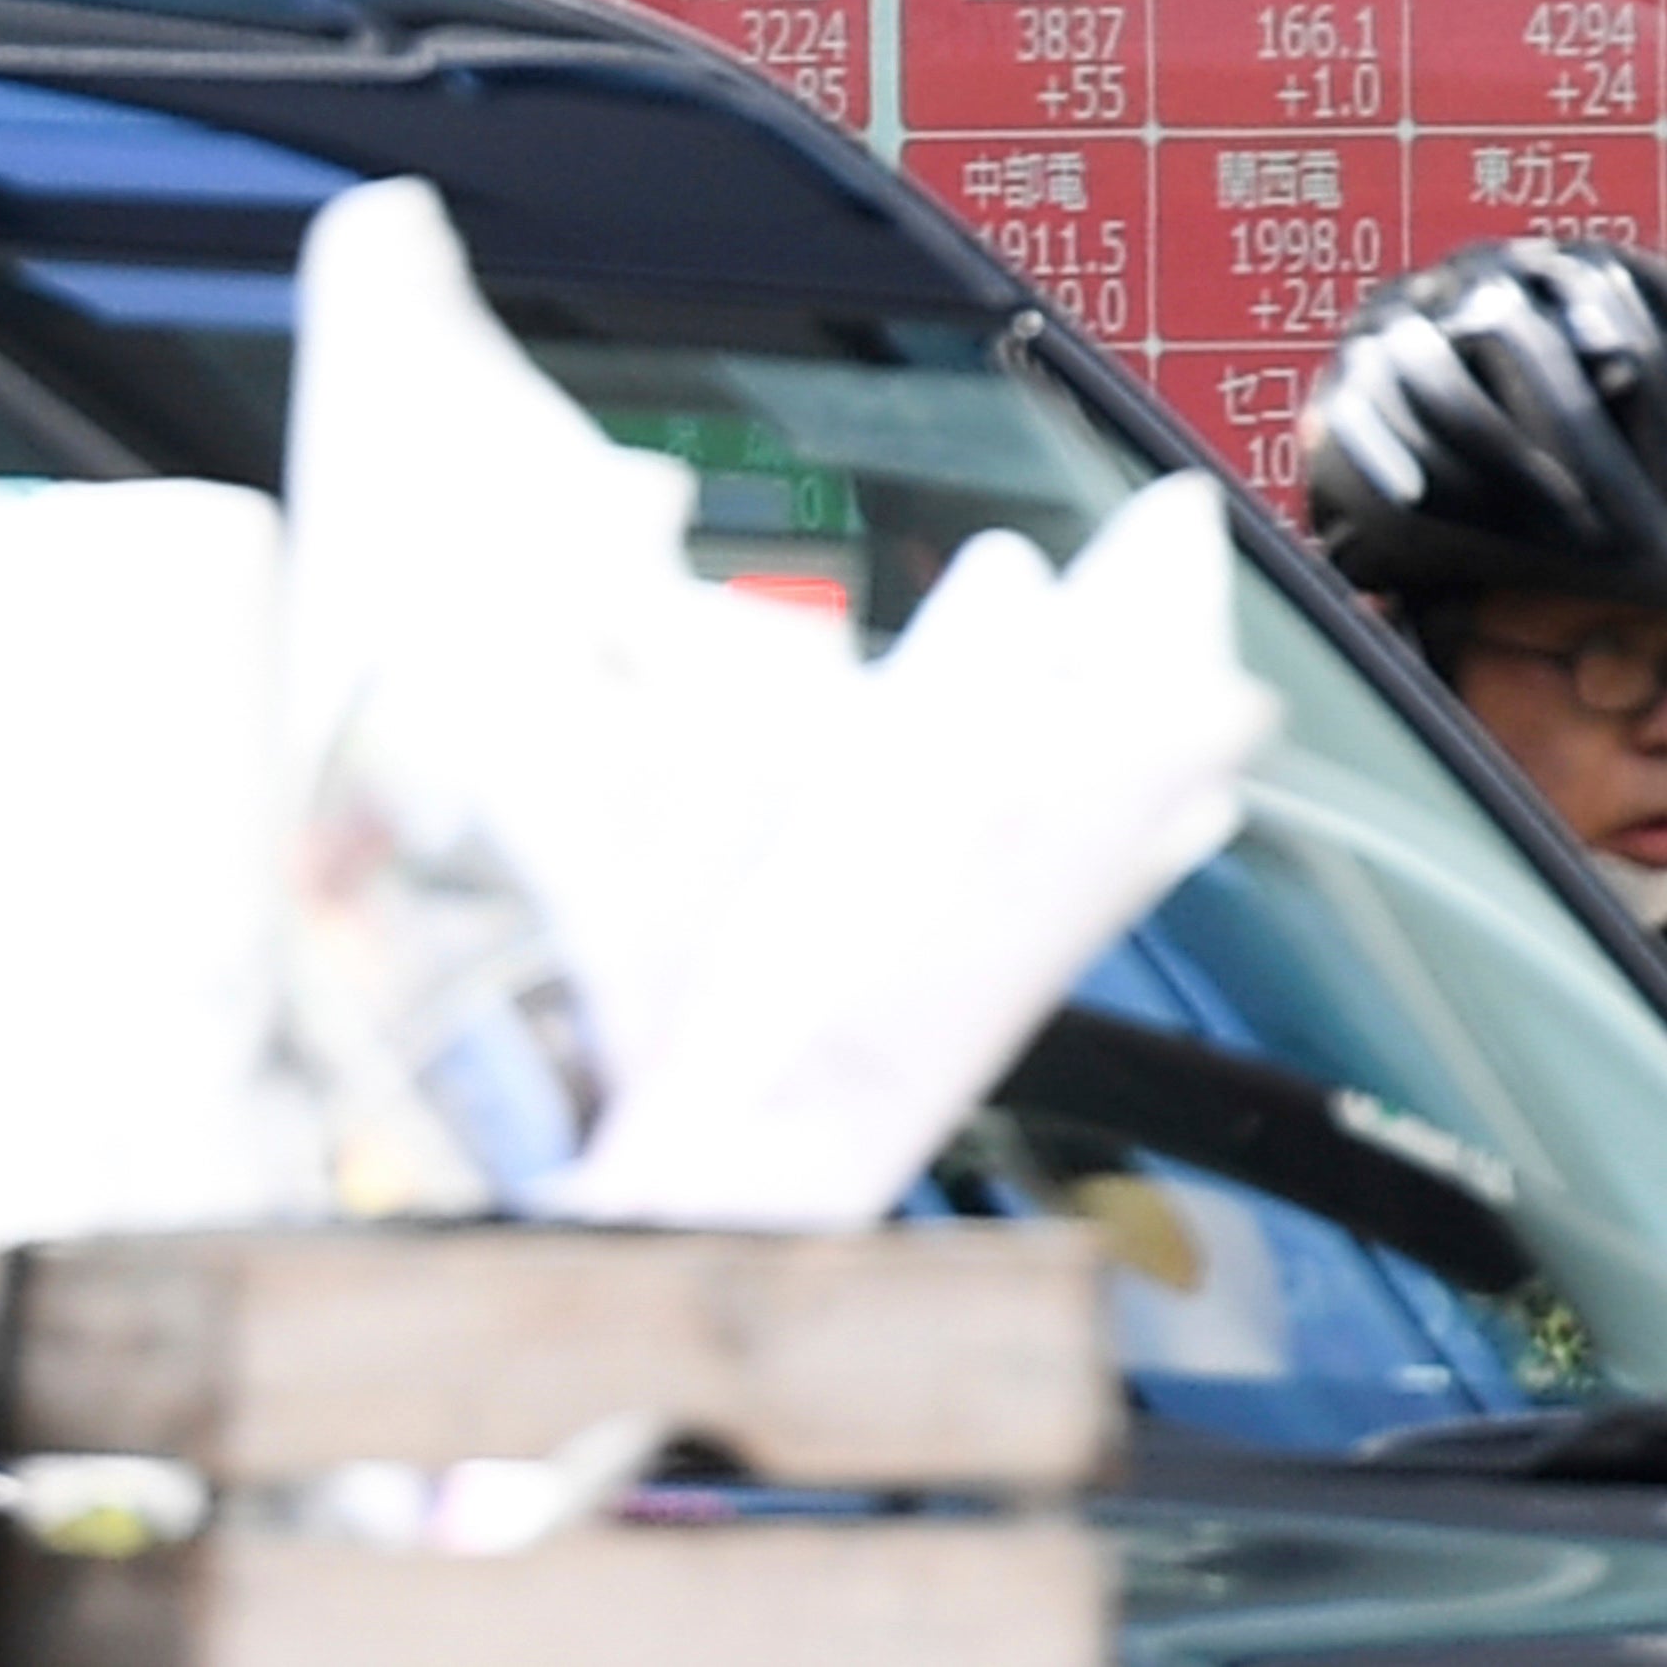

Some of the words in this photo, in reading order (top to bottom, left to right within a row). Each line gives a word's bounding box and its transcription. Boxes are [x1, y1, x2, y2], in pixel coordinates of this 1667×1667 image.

[740, 10, 847, 64] 3224
[1016, 6, 1125, 63] 3837
[1256, 5, 1378, 60] 166.1
[1523, 2, 1636, 56] 4294
[1037, 66, 1125, 121] +55
[1276, 66, 1381, 119] +1.0
[1548, 63, 1636, 115] +24
[1470, 143, 1598, 206] 東ガス
[1229, 217, 1381, 273] 1998.0
